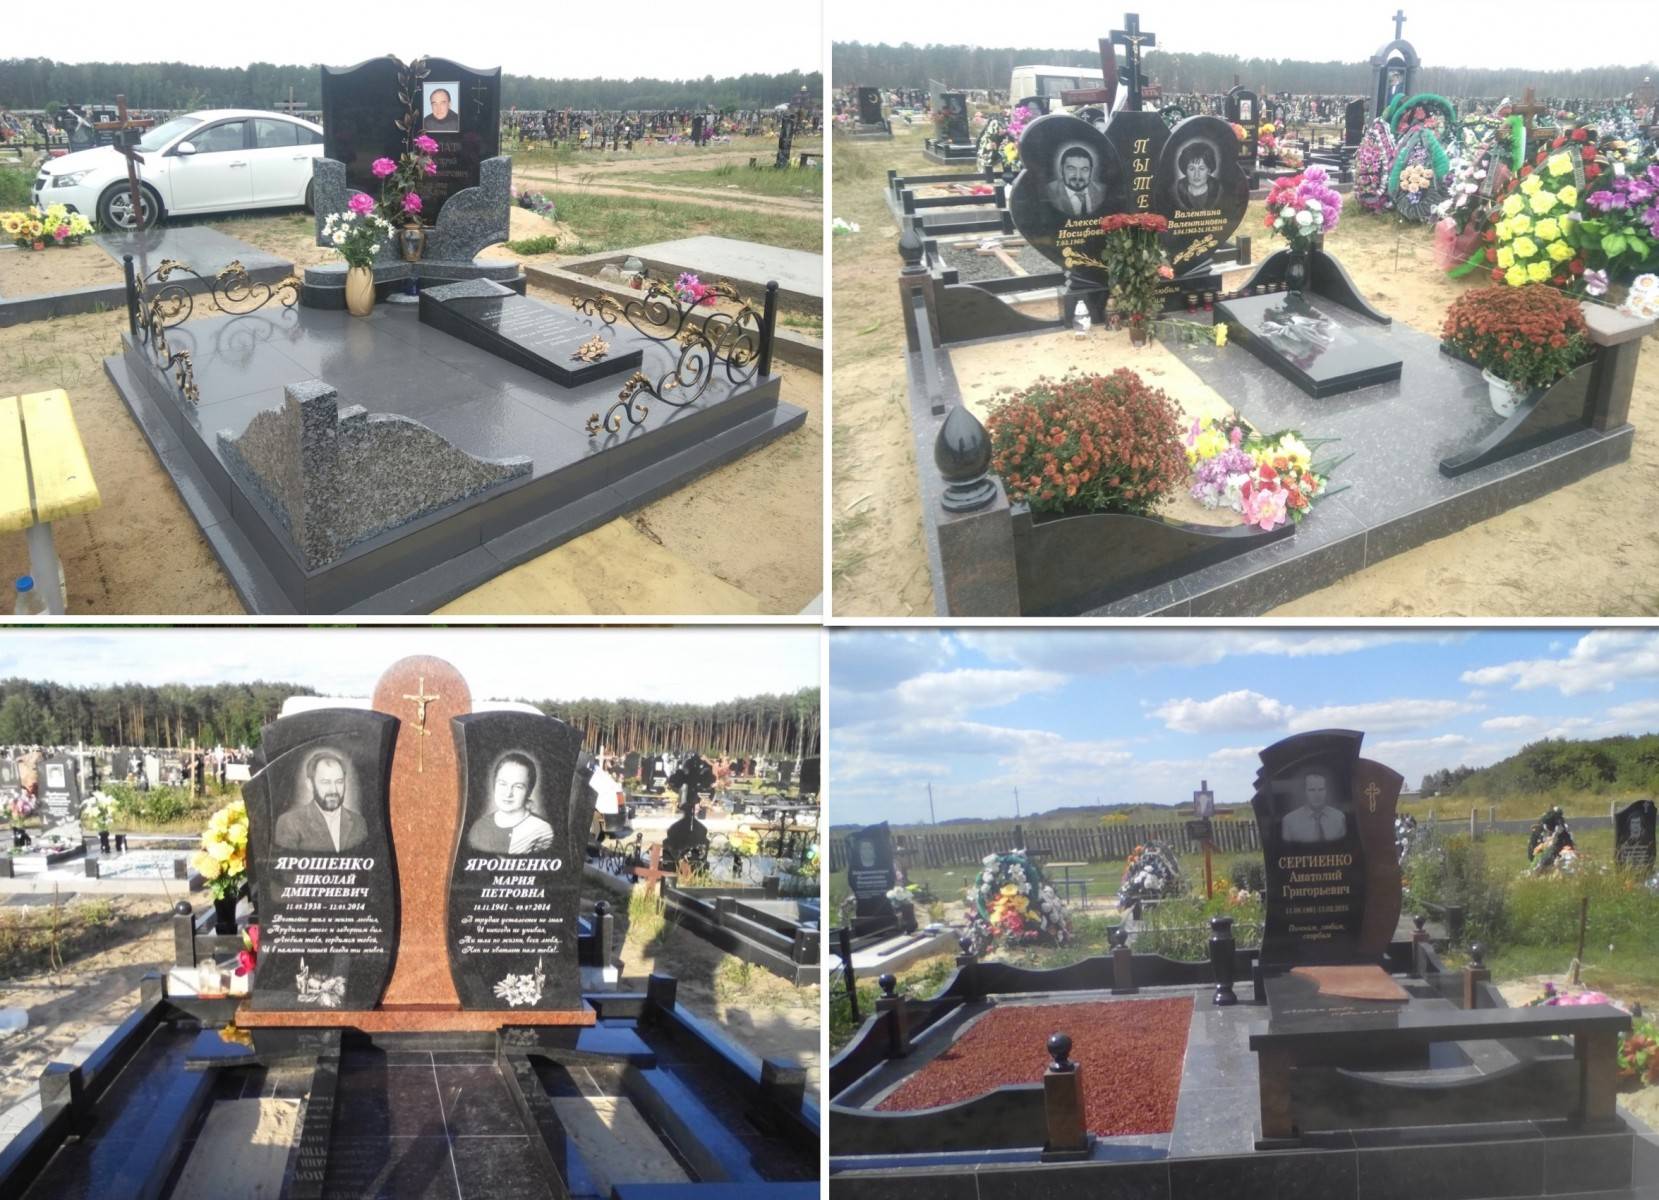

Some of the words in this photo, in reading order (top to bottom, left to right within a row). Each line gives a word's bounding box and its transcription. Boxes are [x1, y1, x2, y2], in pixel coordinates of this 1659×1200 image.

[1174, 209, 1221, 219] Валентина
[1168, 217, 1228, 229] Валентиновна
[1059, 227, 1105, 239] Иосифов
[274, 857, 375, 871] ЯРОШЕНКО
[464, 858, 563, 872] ЯРОШЕНКО
[1278, 854, 1353, 869] СЕРГИЕНКО
[294, 874, 357, 885] НИКОЛАЙ
[492, 875, 536, 886] МАРИЯ
[1289, 870, 1343, 883] Анатолий
[281, 887, 370, 898] ДМИТРИЕВИЧ
[480, 888, 545, 898] ПЕТРОВНА
[1282, 885, 1351, 899] Григорьевич
